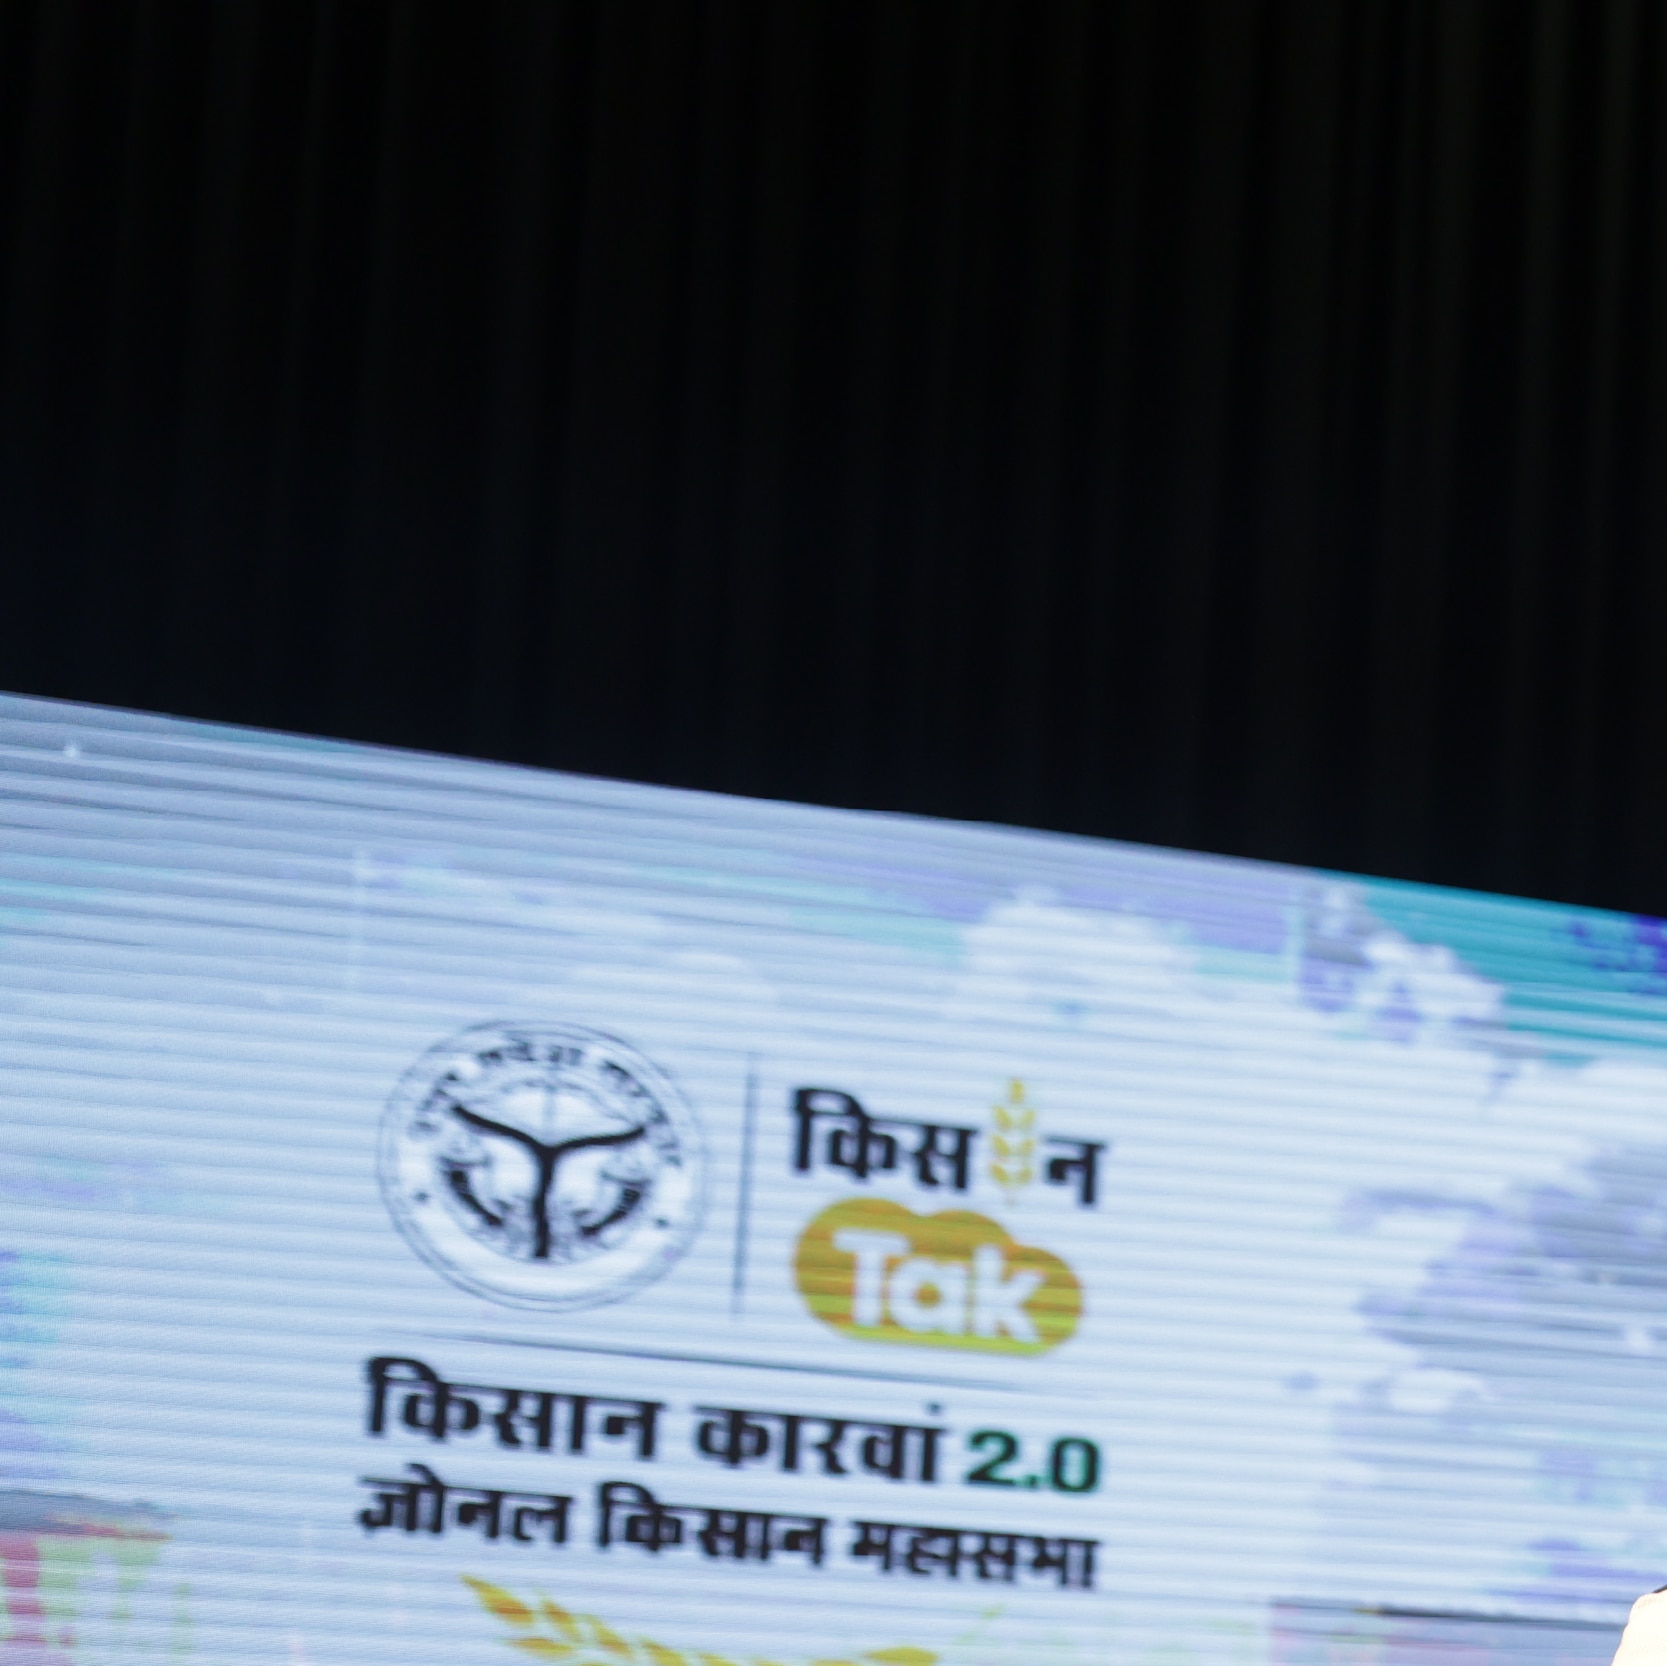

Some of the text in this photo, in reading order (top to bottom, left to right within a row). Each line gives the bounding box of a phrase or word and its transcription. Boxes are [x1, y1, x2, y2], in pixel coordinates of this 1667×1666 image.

[831, 1228, 1047, 1344] Tak
[365, 1356, 1100, 1493] किसान कारवां 2.0
[595, 1482, 827, 1567] किसान
[848, 1518, 1100, 1588] महासभा
